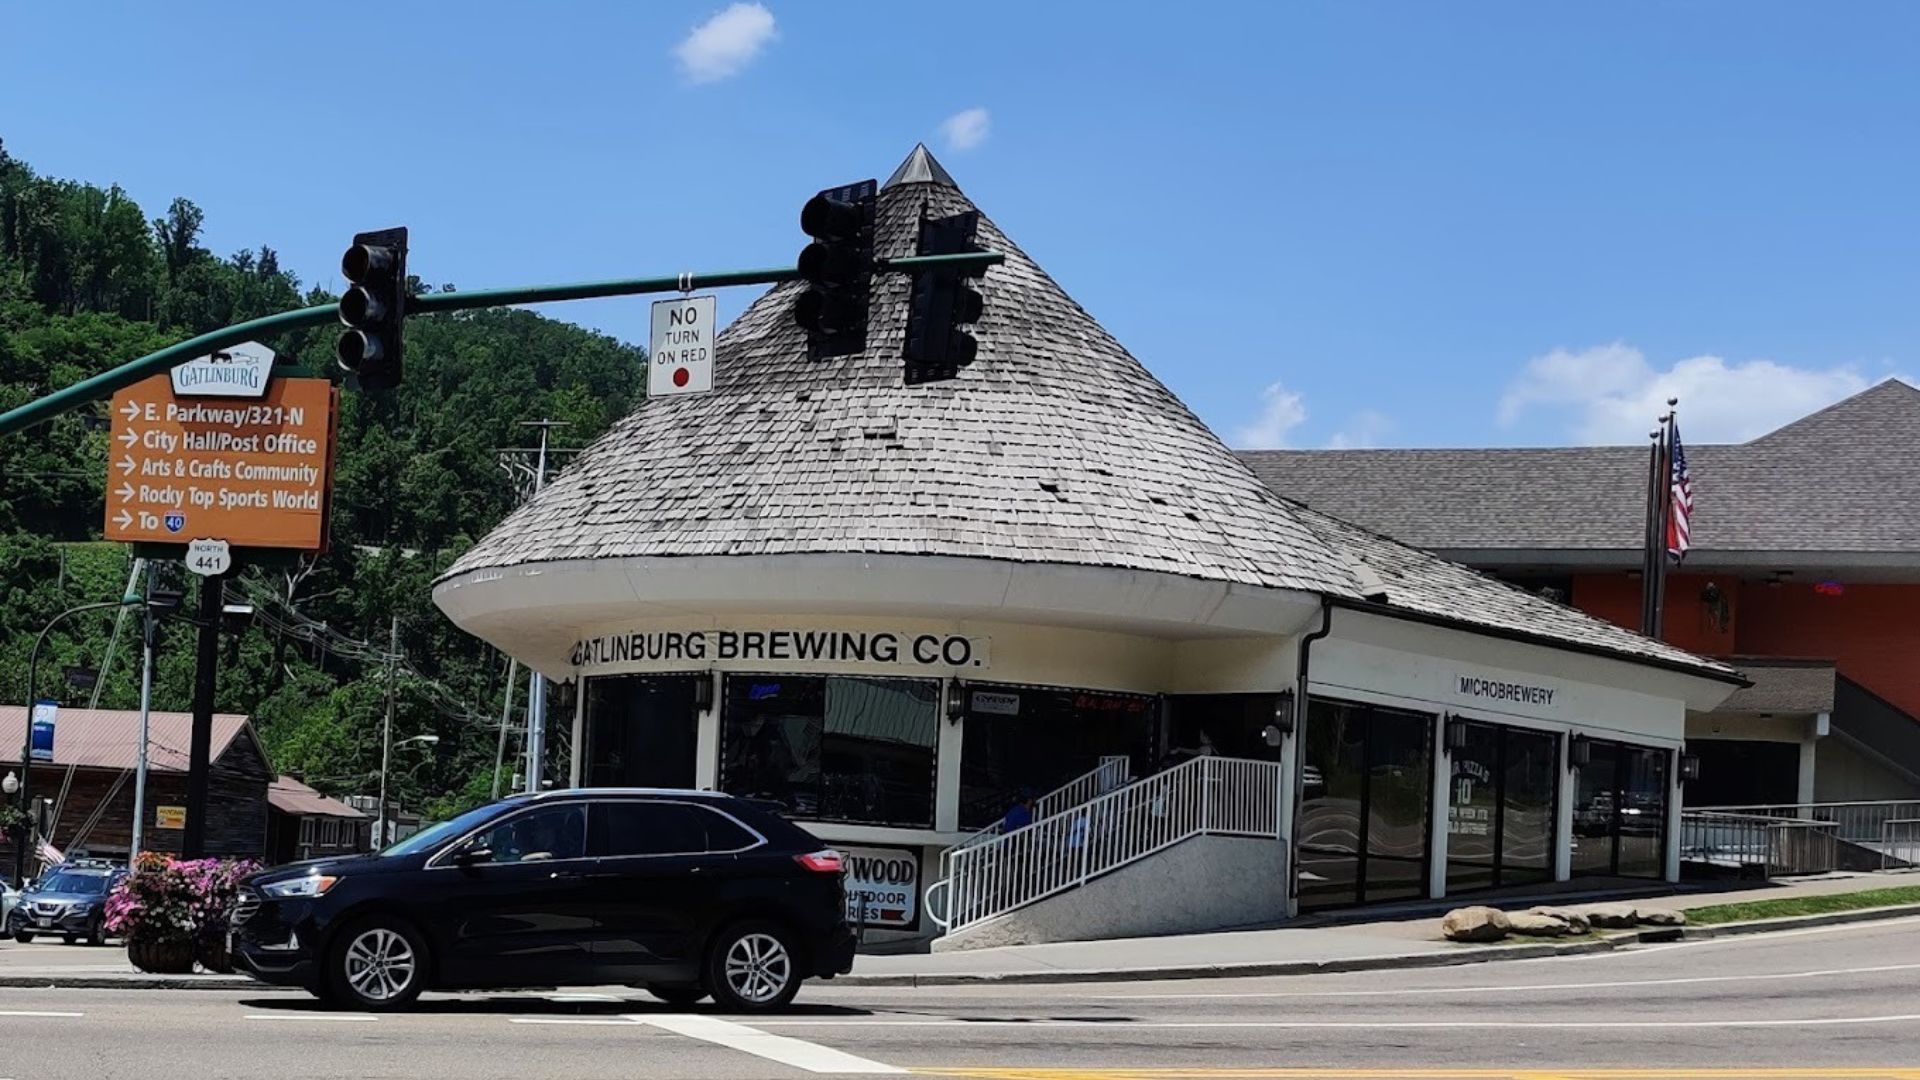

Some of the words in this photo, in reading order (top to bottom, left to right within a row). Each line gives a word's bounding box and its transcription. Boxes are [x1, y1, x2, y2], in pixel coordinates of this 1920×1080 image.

[670, 307, 697, 327] NO
[666, 329, 700, 345] TURN
[657, 351, 676, 365] ON
[681, 347, 707, 363] RED
[180, 365, 259, 389] GATLINBURG
[144, 403, 160, 421] E.
[166, 403, 304, 428] Parkway/321-N
[143, 430, 178, 454] City
[183, 431, 259, 453] Hall/Post
[264, 434, 317, 454] Office
[141, 458, 171, 477] Arts
[174, 460, 186, 477] &
[189, 459, 231, 479] Crafts
[235, 461, 318, 486] Community
[139, 485, 184, 508] Rocky
[189, 487, 214, 510] Top
[219, 488, 268, 511] Sports
[272, 490, 319, 509] World
[138, 511, 159, 530] To
[167, 517, 183, 529] 40
[195, 545, 224, 553] NORTH
[195, 557, 221, 569] 441
[571, 632, 705, 666] GATLINBURG
[718, 631, 898, 662] BREWING
[912, 634, 981, 666] CO.
[1460, 677, 1554, 705] MICROBREWERY
